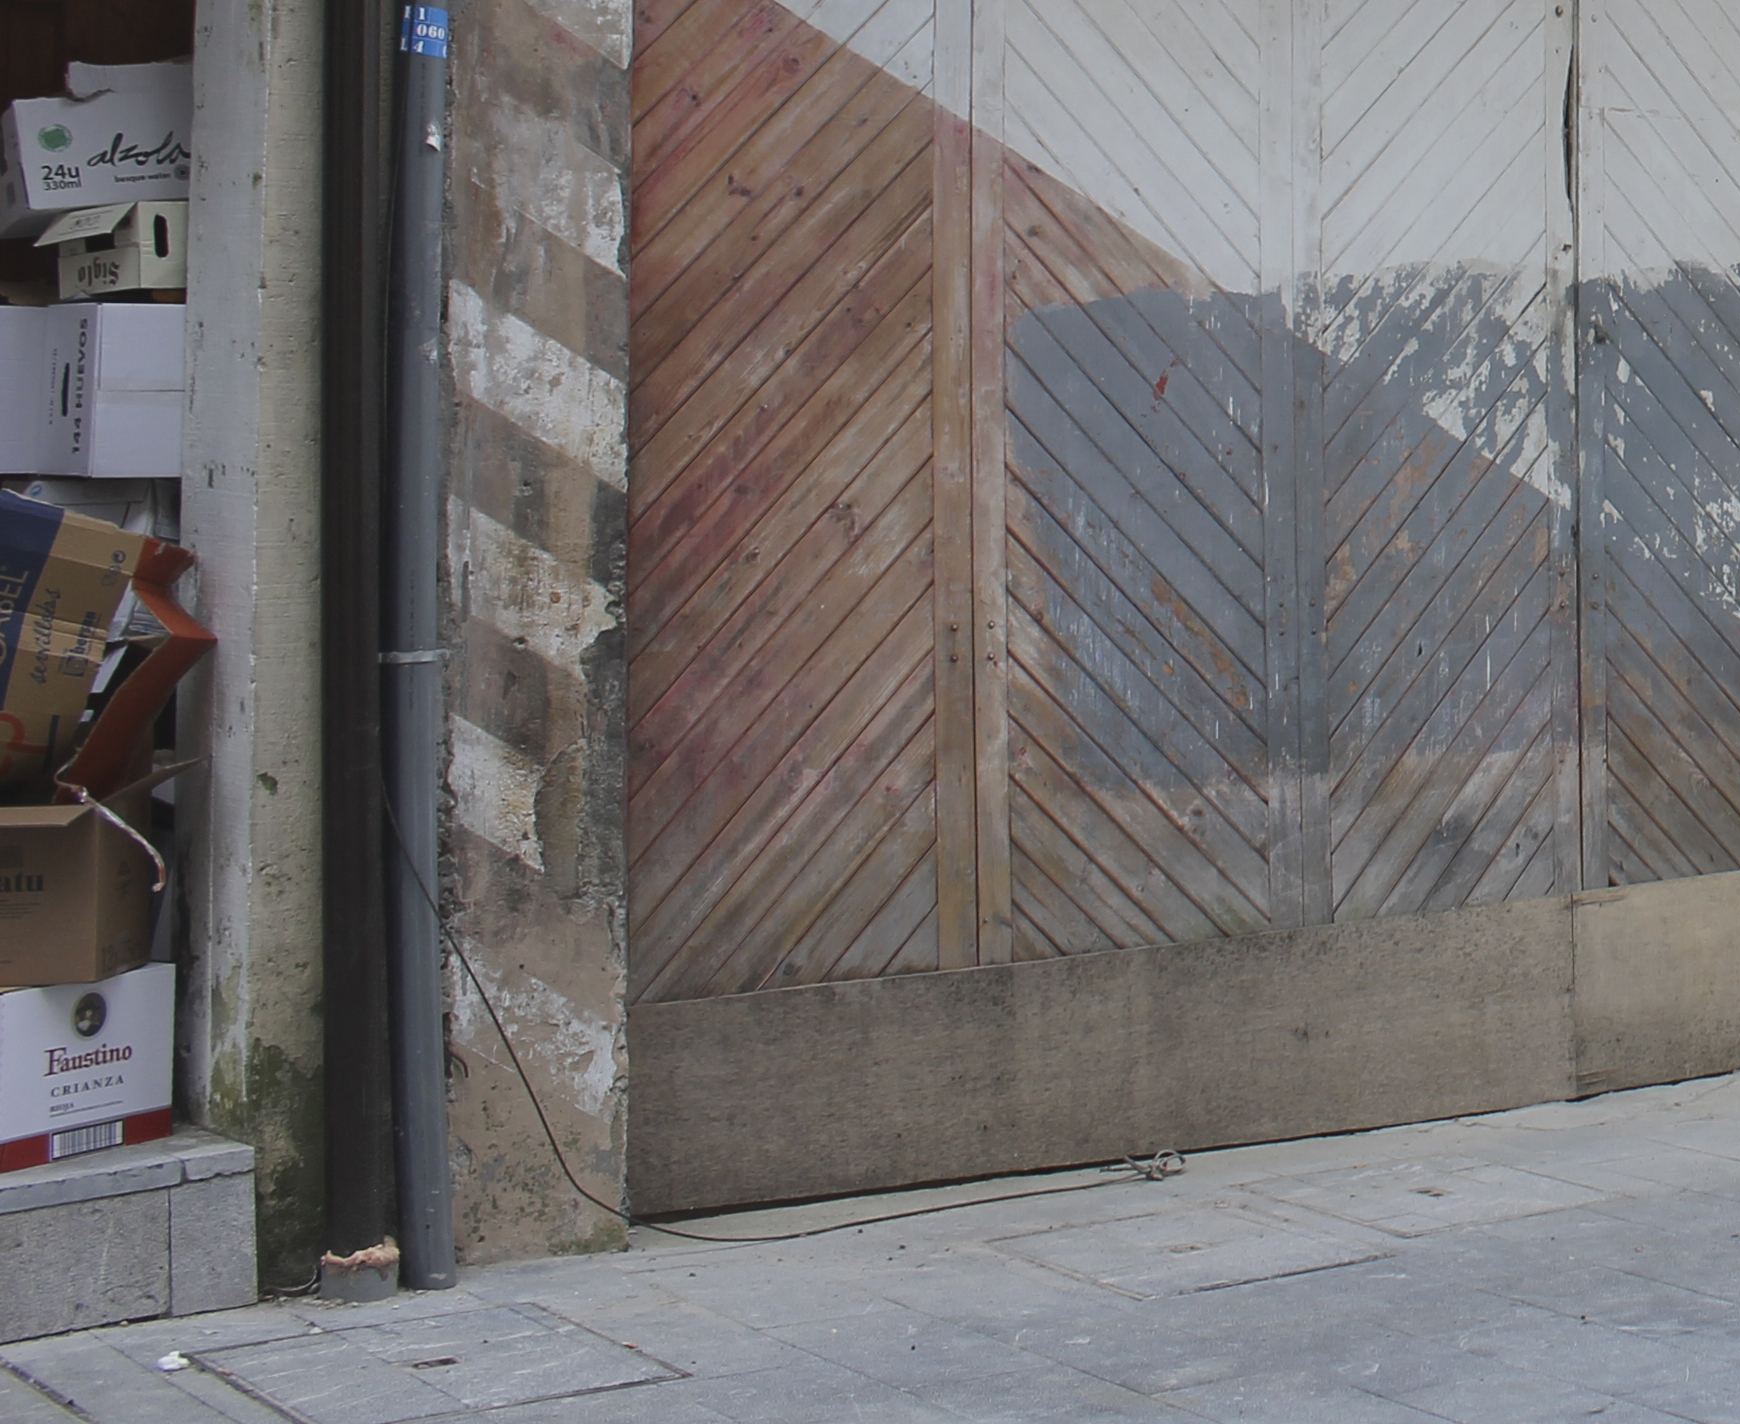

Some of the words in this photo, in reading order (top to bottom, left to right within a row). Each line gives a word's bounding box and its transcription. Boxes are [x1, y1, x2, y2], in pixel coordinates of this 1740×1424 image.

[41, 165, 80, 181] 24u
[43, 179, 82, 191] 330ml
[75, 318, 88, 409] HUEVOS
[43, 1043, 133, 1077] Faustino
[51, 1075, 125, 1097] CRIANZA
